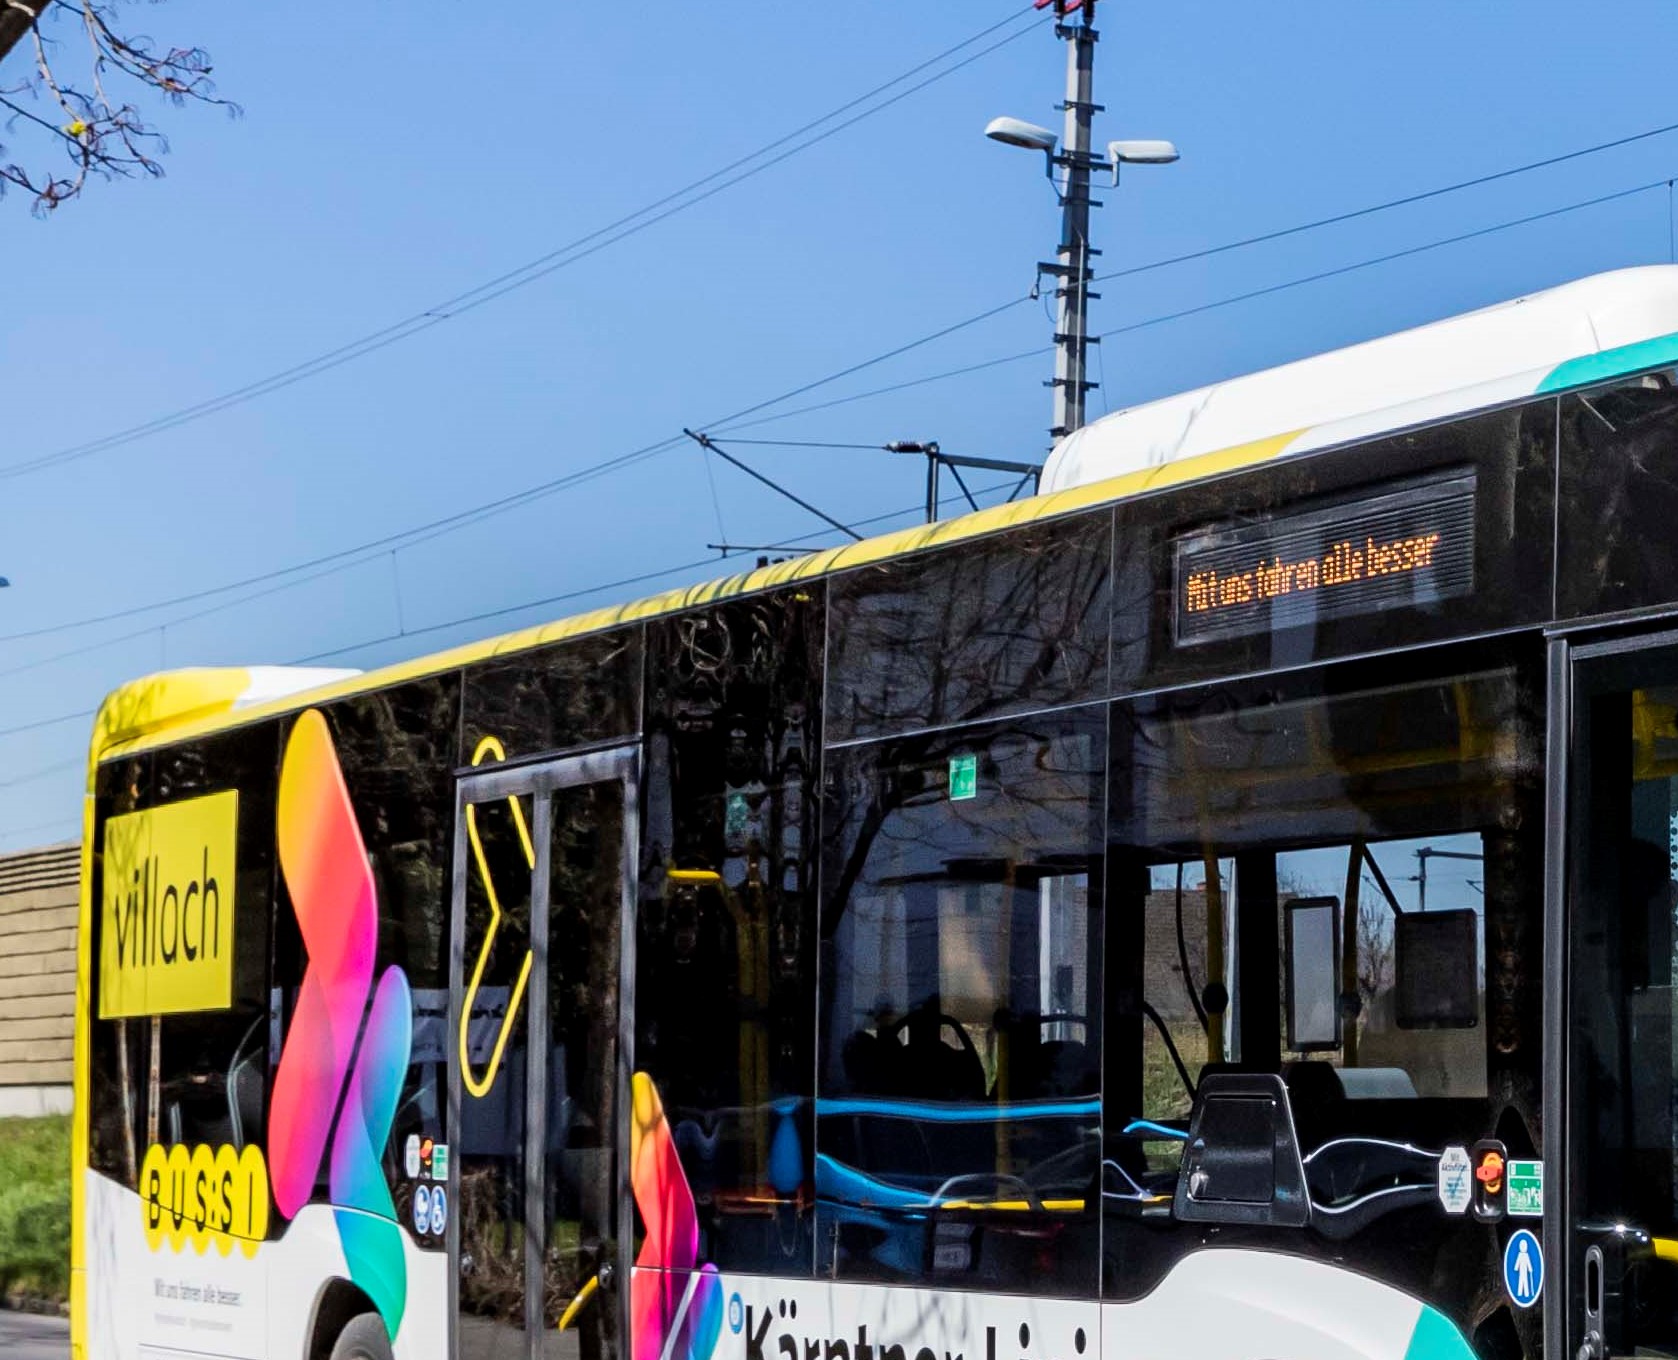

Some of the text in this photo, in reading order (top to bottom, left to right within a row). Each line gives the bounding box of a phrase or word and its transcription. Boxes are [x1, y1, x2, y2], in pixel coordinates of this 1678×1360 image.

[1256, 556, 1319, 599] fahren
[1322, 540, 1364, 585] alle
[1367, 534, 1440, 577] besser
[115, 845, 219, 970] villach
